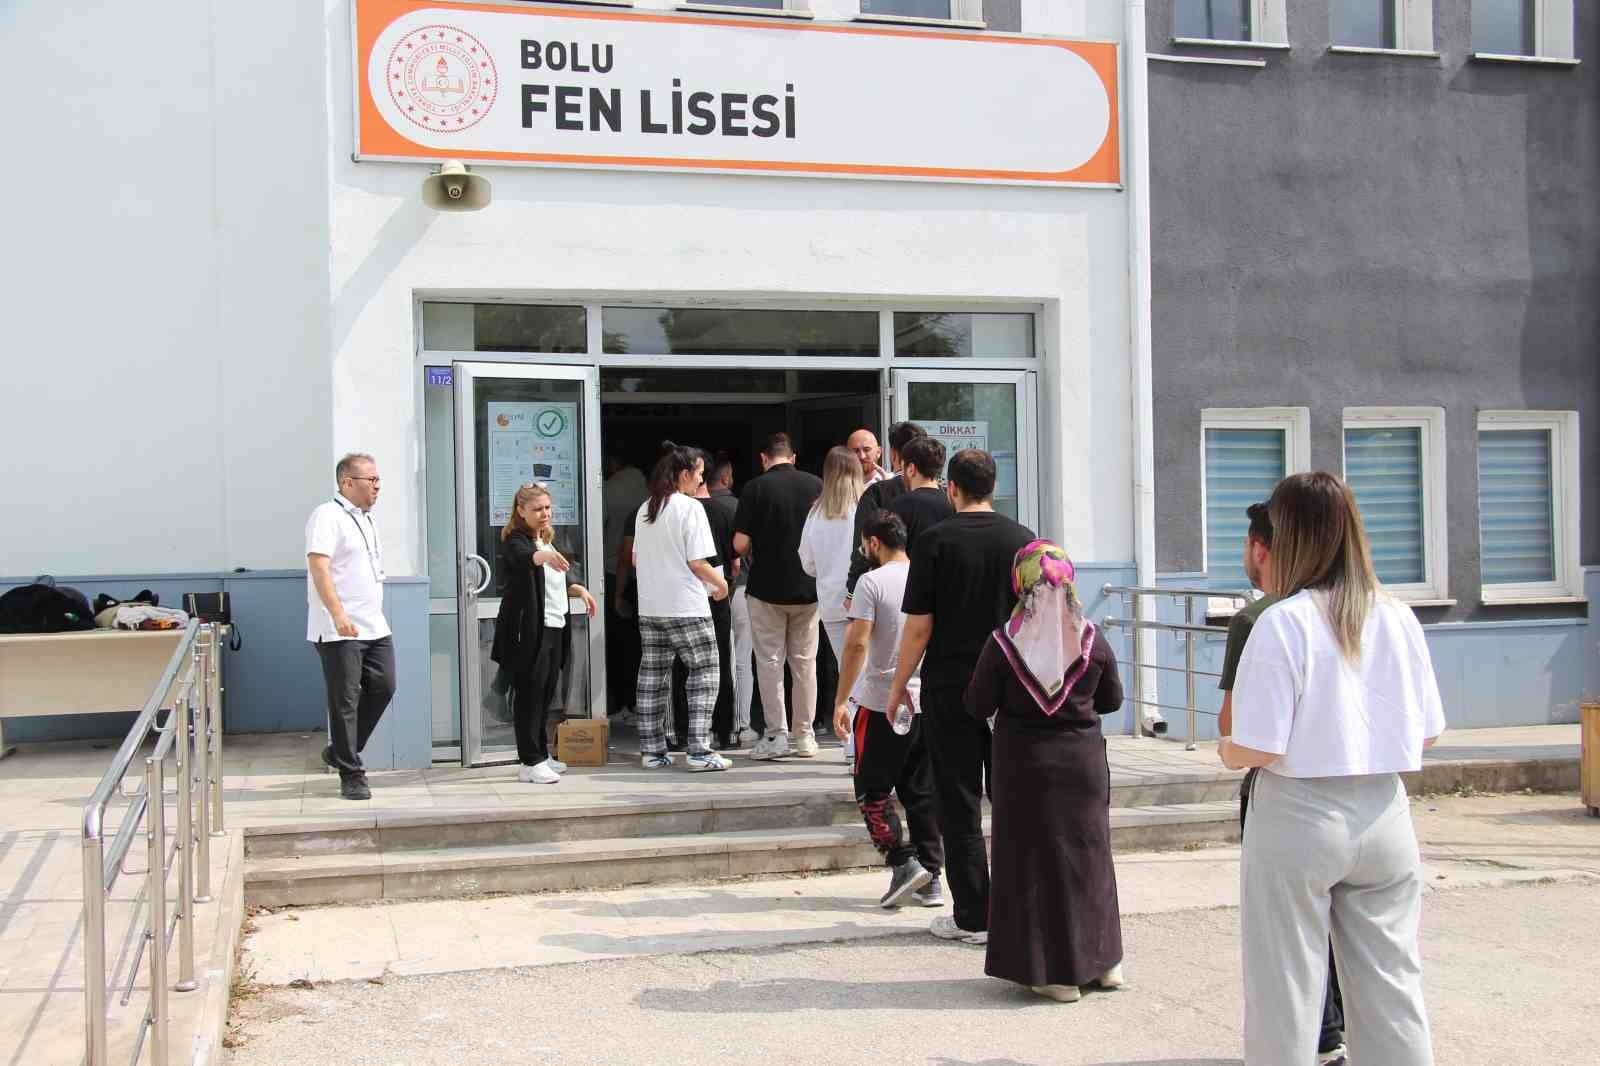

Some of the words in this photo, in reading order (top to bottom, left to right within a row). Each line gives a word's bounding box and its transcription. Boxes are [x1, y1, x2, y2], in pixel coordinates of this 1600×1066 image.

[520, 40, 614, 74] BOLU
[520, 83, 622, 133] FEN
[640, 78, 796, 139] LİSESİ
[431, 375, 452, 385] 11/2
[940, 424, 976, 435] DİKKAT
